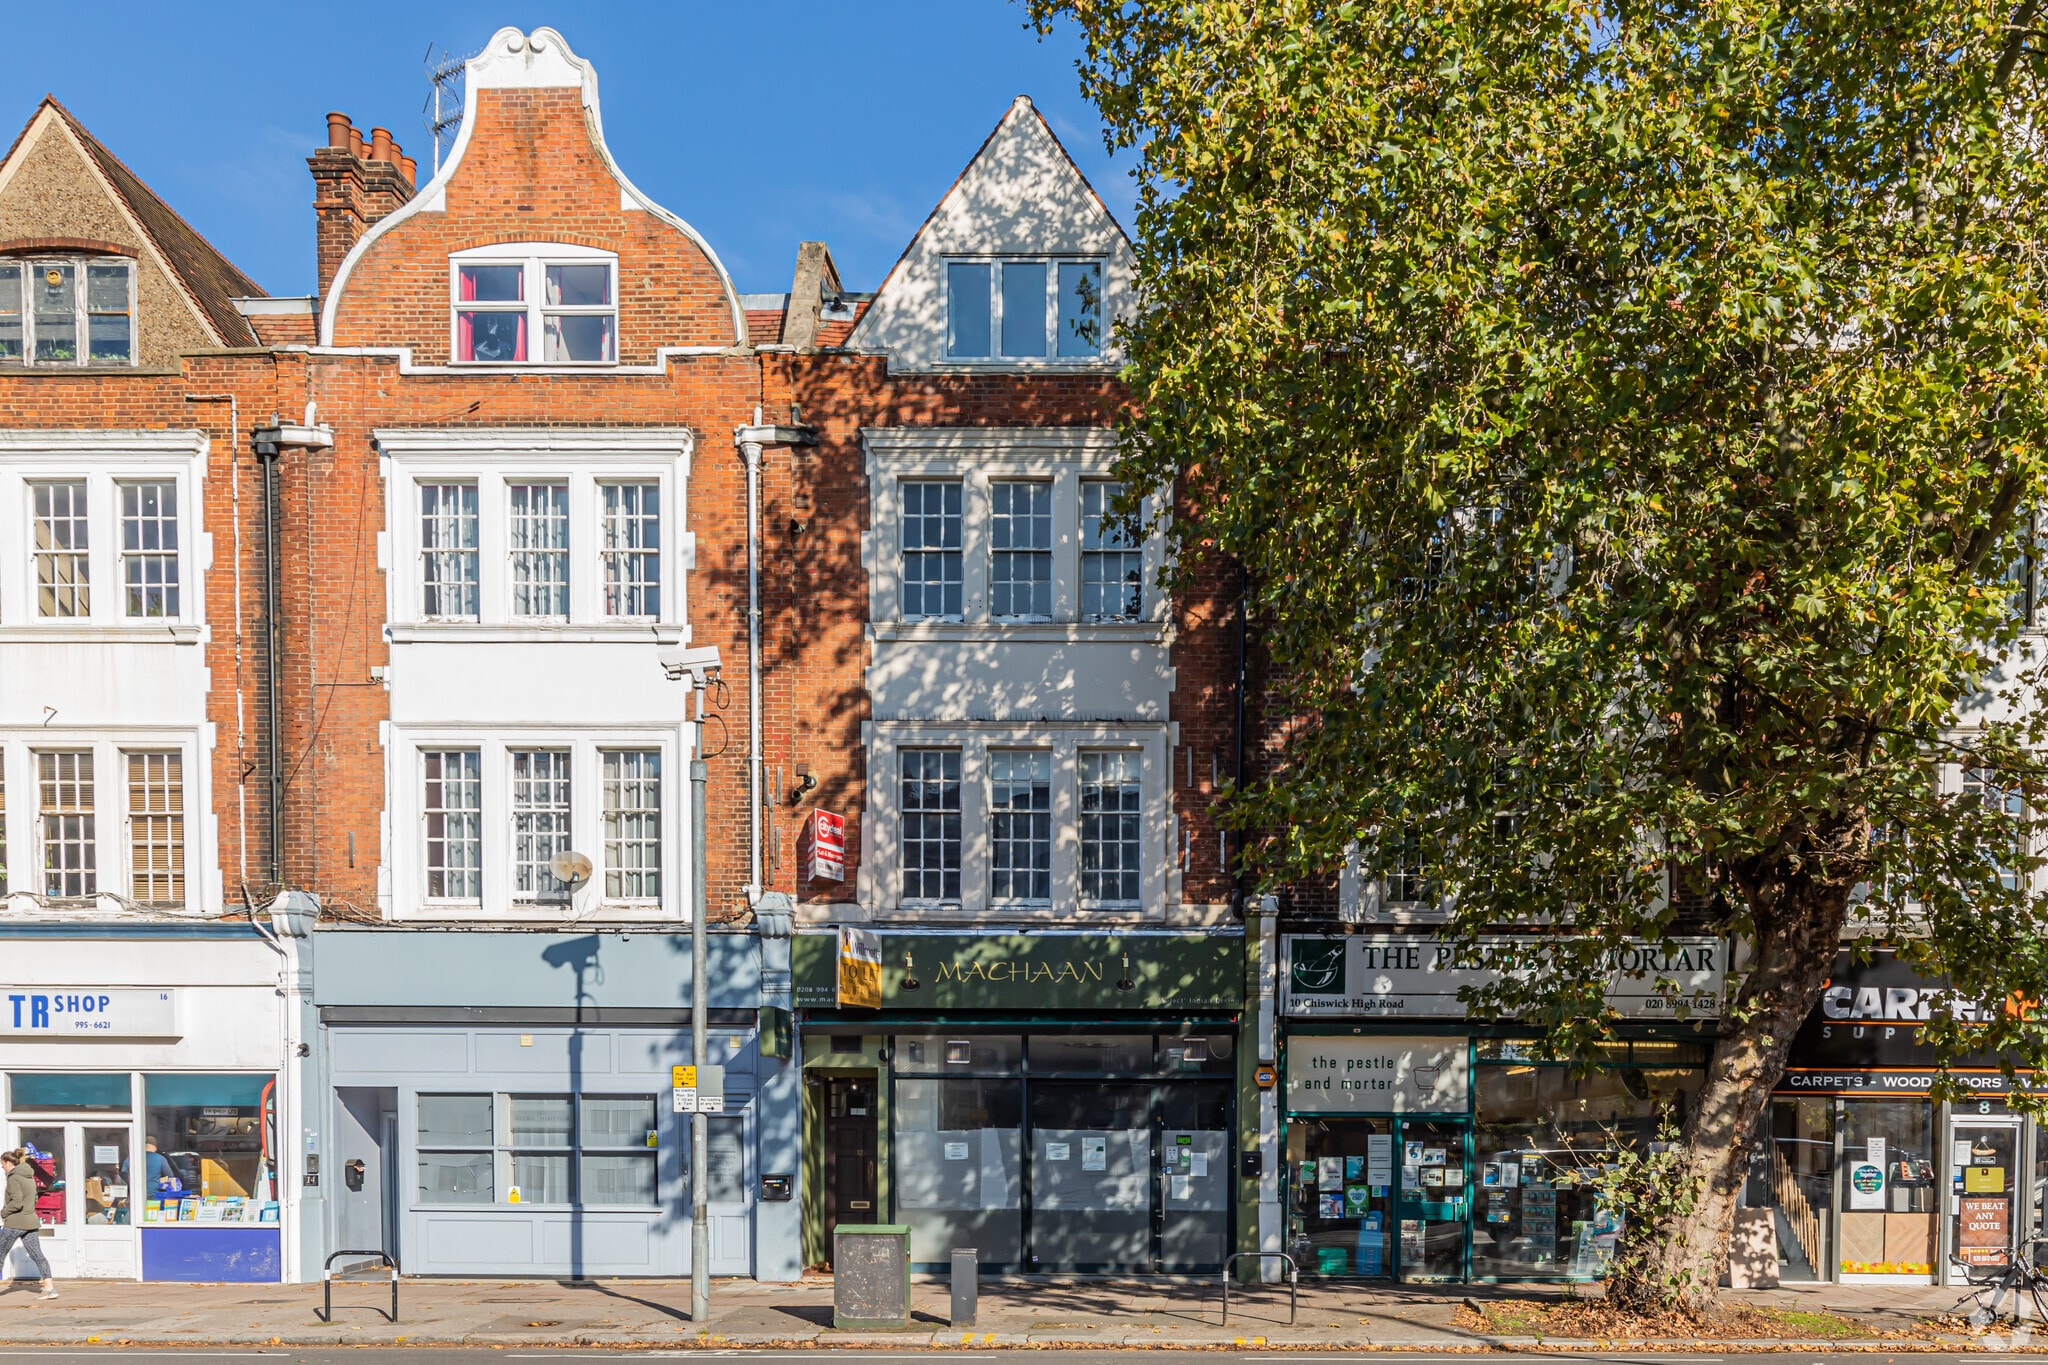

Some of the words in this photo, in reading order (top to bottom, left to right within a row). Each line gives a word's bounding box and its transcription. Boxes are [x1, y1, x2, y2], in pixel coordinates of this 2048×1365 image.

[1363, 946, 1420, 970] THE
[841, 963, 858, 979] TO
[863, 966, 880, 983] LET
[935, 961, 1103, 984] MACHAAN
[54, 995, 110, 1013] SHOP
[160, 993, 168, 1001] 16
[1645, 999, 1663, 1009] 020
[1693, 999, 1716, 1009] 1428
[1290, 998, 1301, 1008] 10
[1303, 998, 1349, 1008] Chiswick
[1351, 998, 1376, 1012] High
[1378, 999, 1404, 1009] Road
[1312, 1055, 1337, 1069] the
[1347, 1055, 1394, 1073] pestle
[1305, 1076, 1331, 1090] and
[1341, 1078, 1393, 1090] mortar
[1790, 1075, 1863, 1089] CARPETS
[1883, 1076, 1932, 1089] WOOD
[1979, 1101, 1991, 1114] 8
[306, 1176, 316, 1184] 14
[1965, 1202, 1980, 1210] WE
[1981, 1202, 2005, 1210] BEAT
[1975, 1212, 1995, 1220] ANY
[1968, 1222, 2001, 1231] QUOTE
